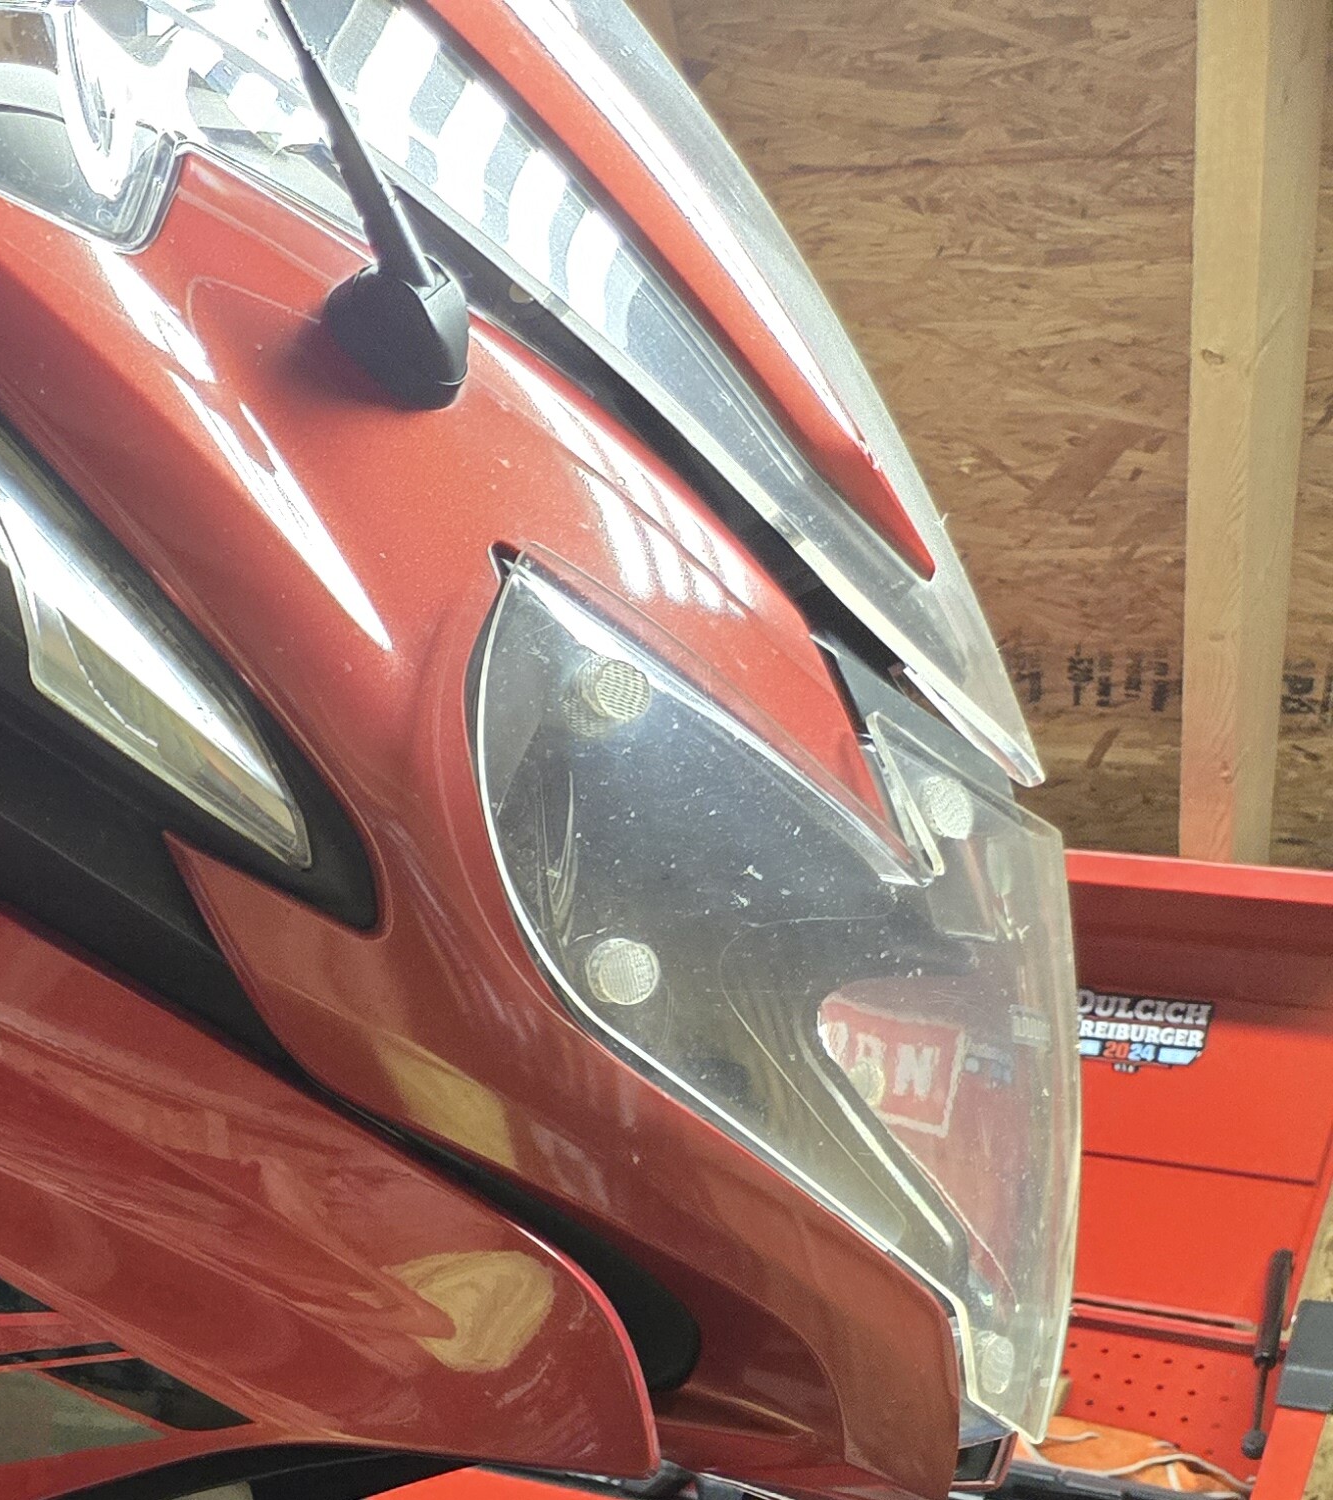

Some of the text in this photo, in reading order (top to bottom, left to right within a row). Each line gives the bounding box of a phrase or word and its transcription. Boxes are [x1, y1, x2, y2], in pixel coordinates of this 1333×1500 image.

[1078, 989, 1211, 1025] DULCICH
[1078, 1016, 1205, 1047] REIBURGER
[1103, 1041, 1156, 1061] 2024
